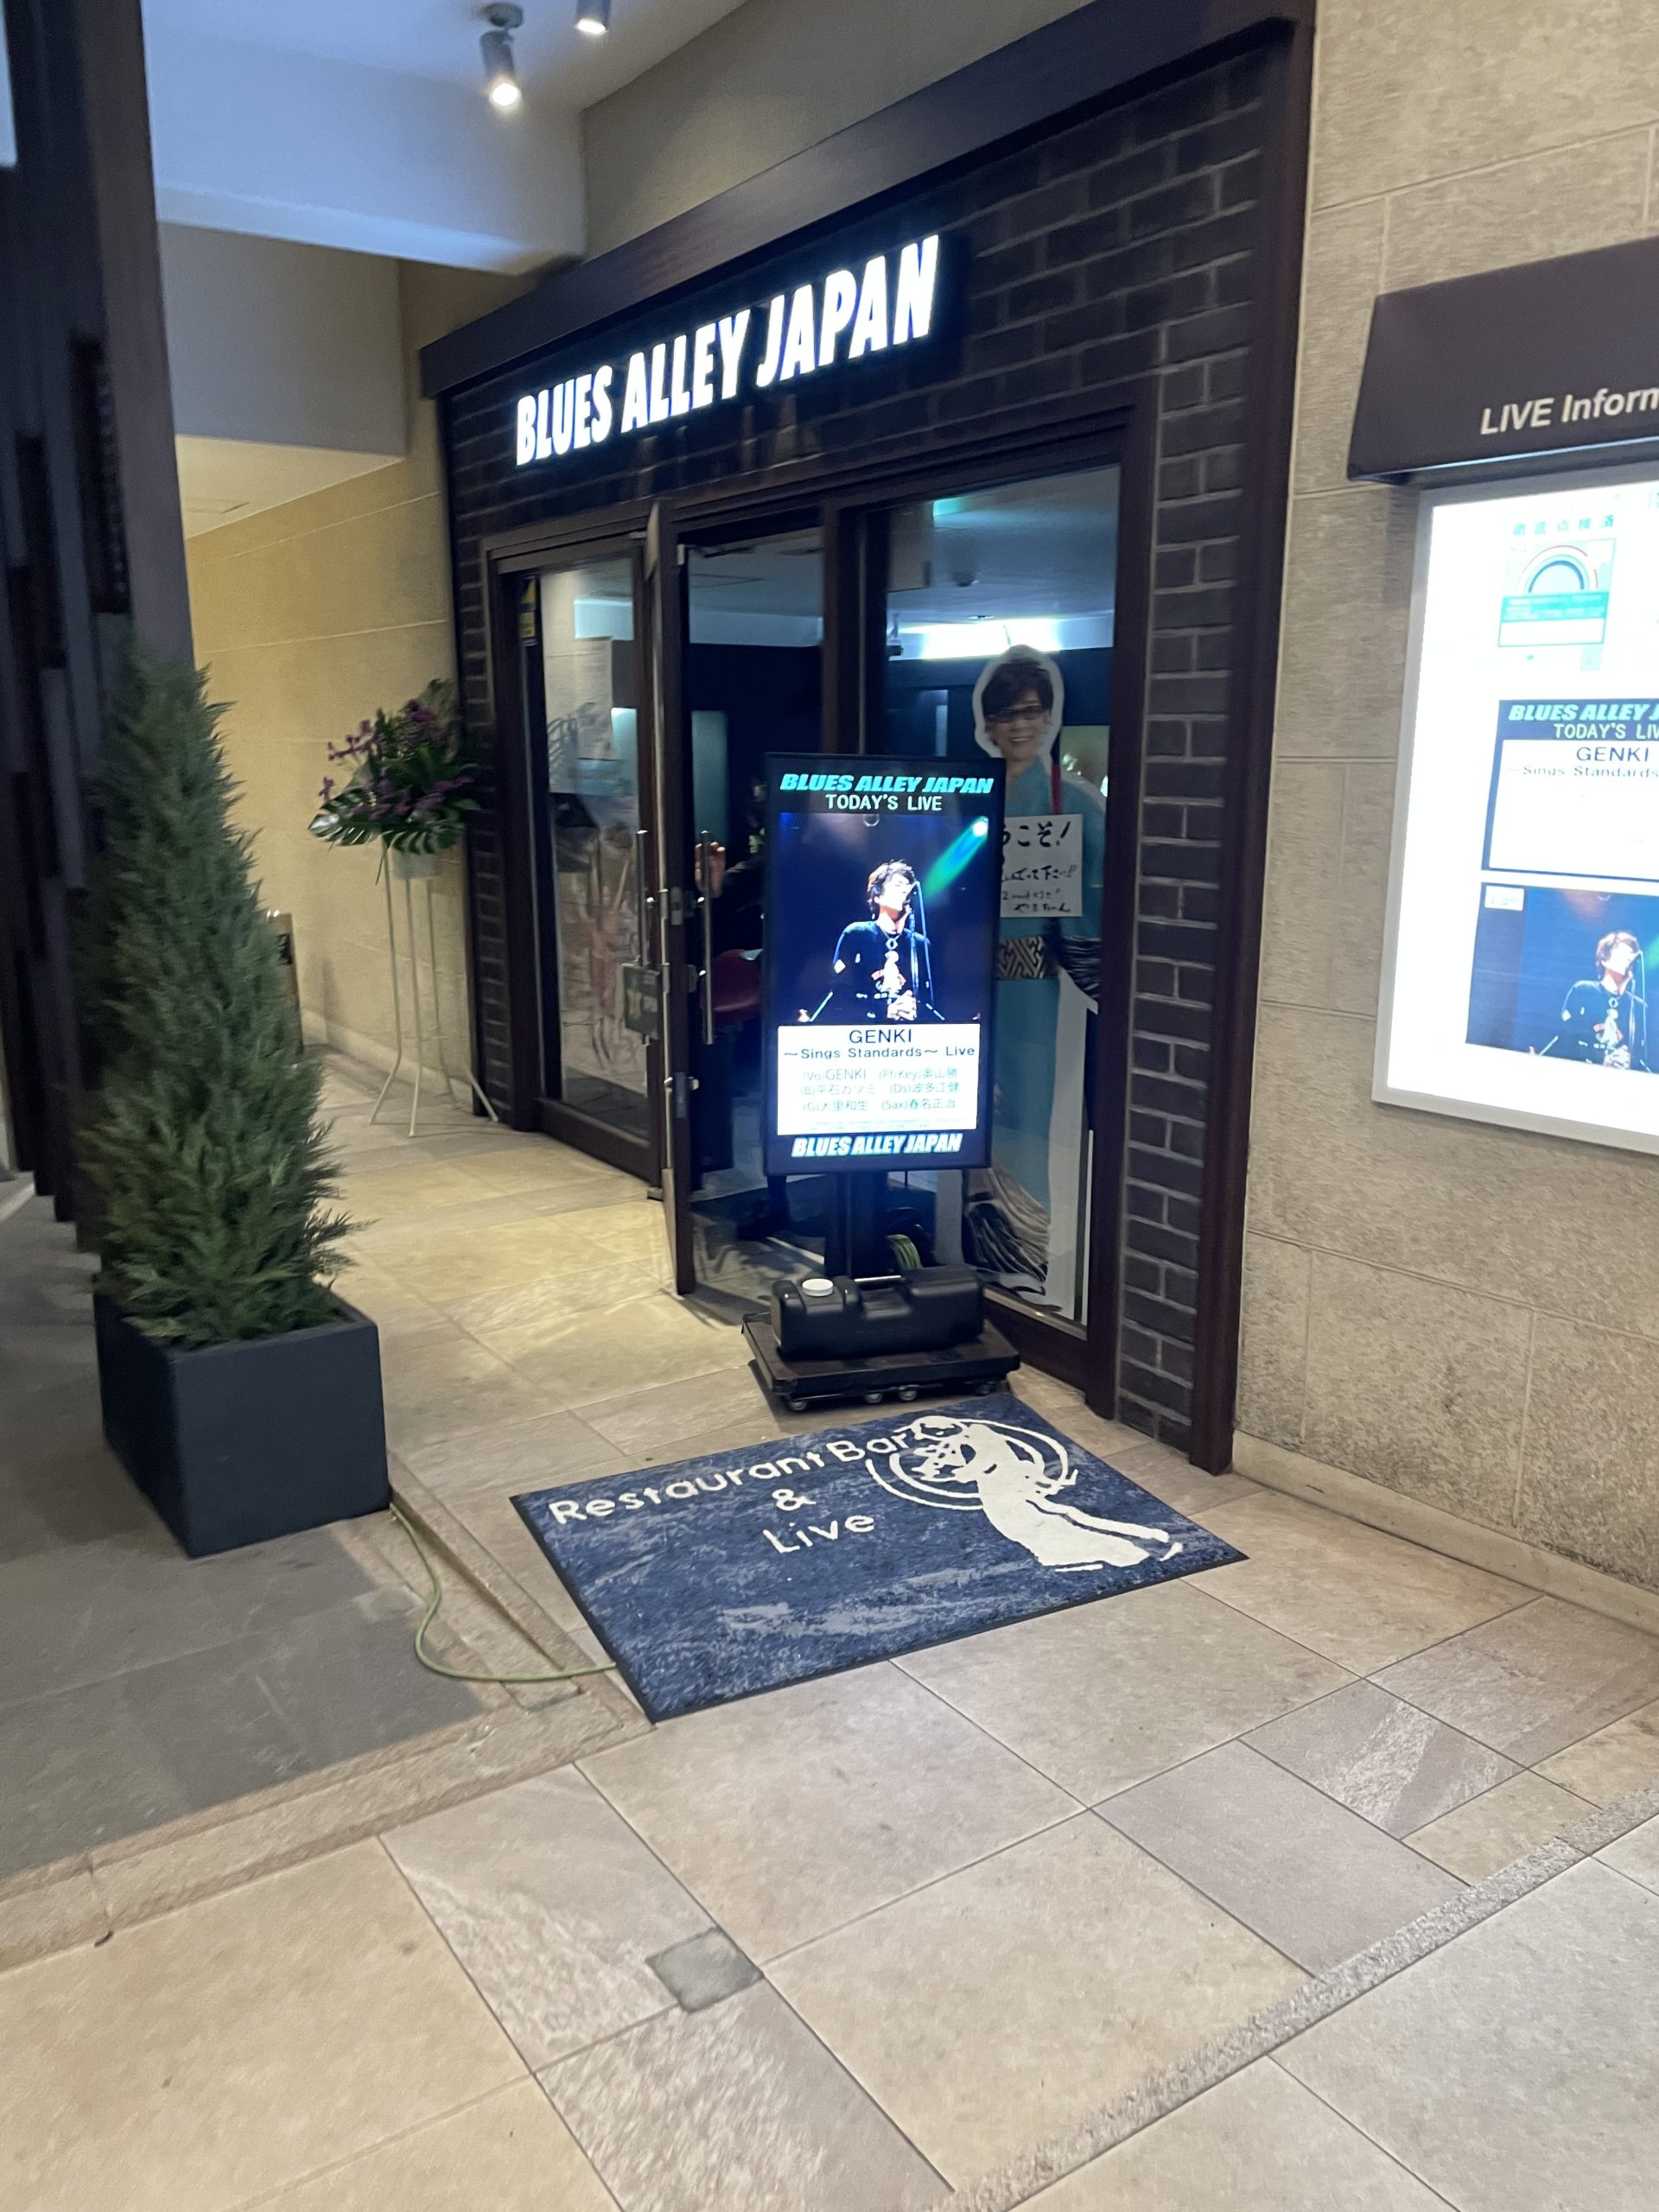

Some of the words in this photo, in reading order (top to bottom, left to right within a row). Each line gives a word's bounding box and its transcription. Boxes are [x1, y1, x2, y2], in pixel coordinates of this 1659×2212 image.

[516, 365, 613, 467] BLUES
[620, 308, 751, 433] ALLEY
[755, 234, 939, 388] JAPAN
[1479, 397, 1554, 435] LIVE
[1508, 704, 1578, 721] BLUES
[1580, 704, 1650, 721] ALLEY
[1554, 723, 1626, 740] TODAY'S
[1576, 747, 1649, 762] GENKI
[779, 773, 855, 791] BLUES
[855, 775, 922, 792] ALLEY
[921, 778, 994, 794] JAPAN
[825, 793, 899, 810] TODAY'S
[908, 795, 942, 810] LIVE
[849, 1029, 912, 1044] GENKI
[945, 1046, 976, 1057] Live
[791, 1137, 852, 1158] BLUES
[850, 1135, 906, 1155] ALLEY
[904, 1133, 963, 1154] JAPAN
[548, 1452, 827, 1525] Restaurant
[826, 1430, 915, 1463] Bar
[771, 1489, 817, 1512] &
[762, 1514, 877, 1554] Live
